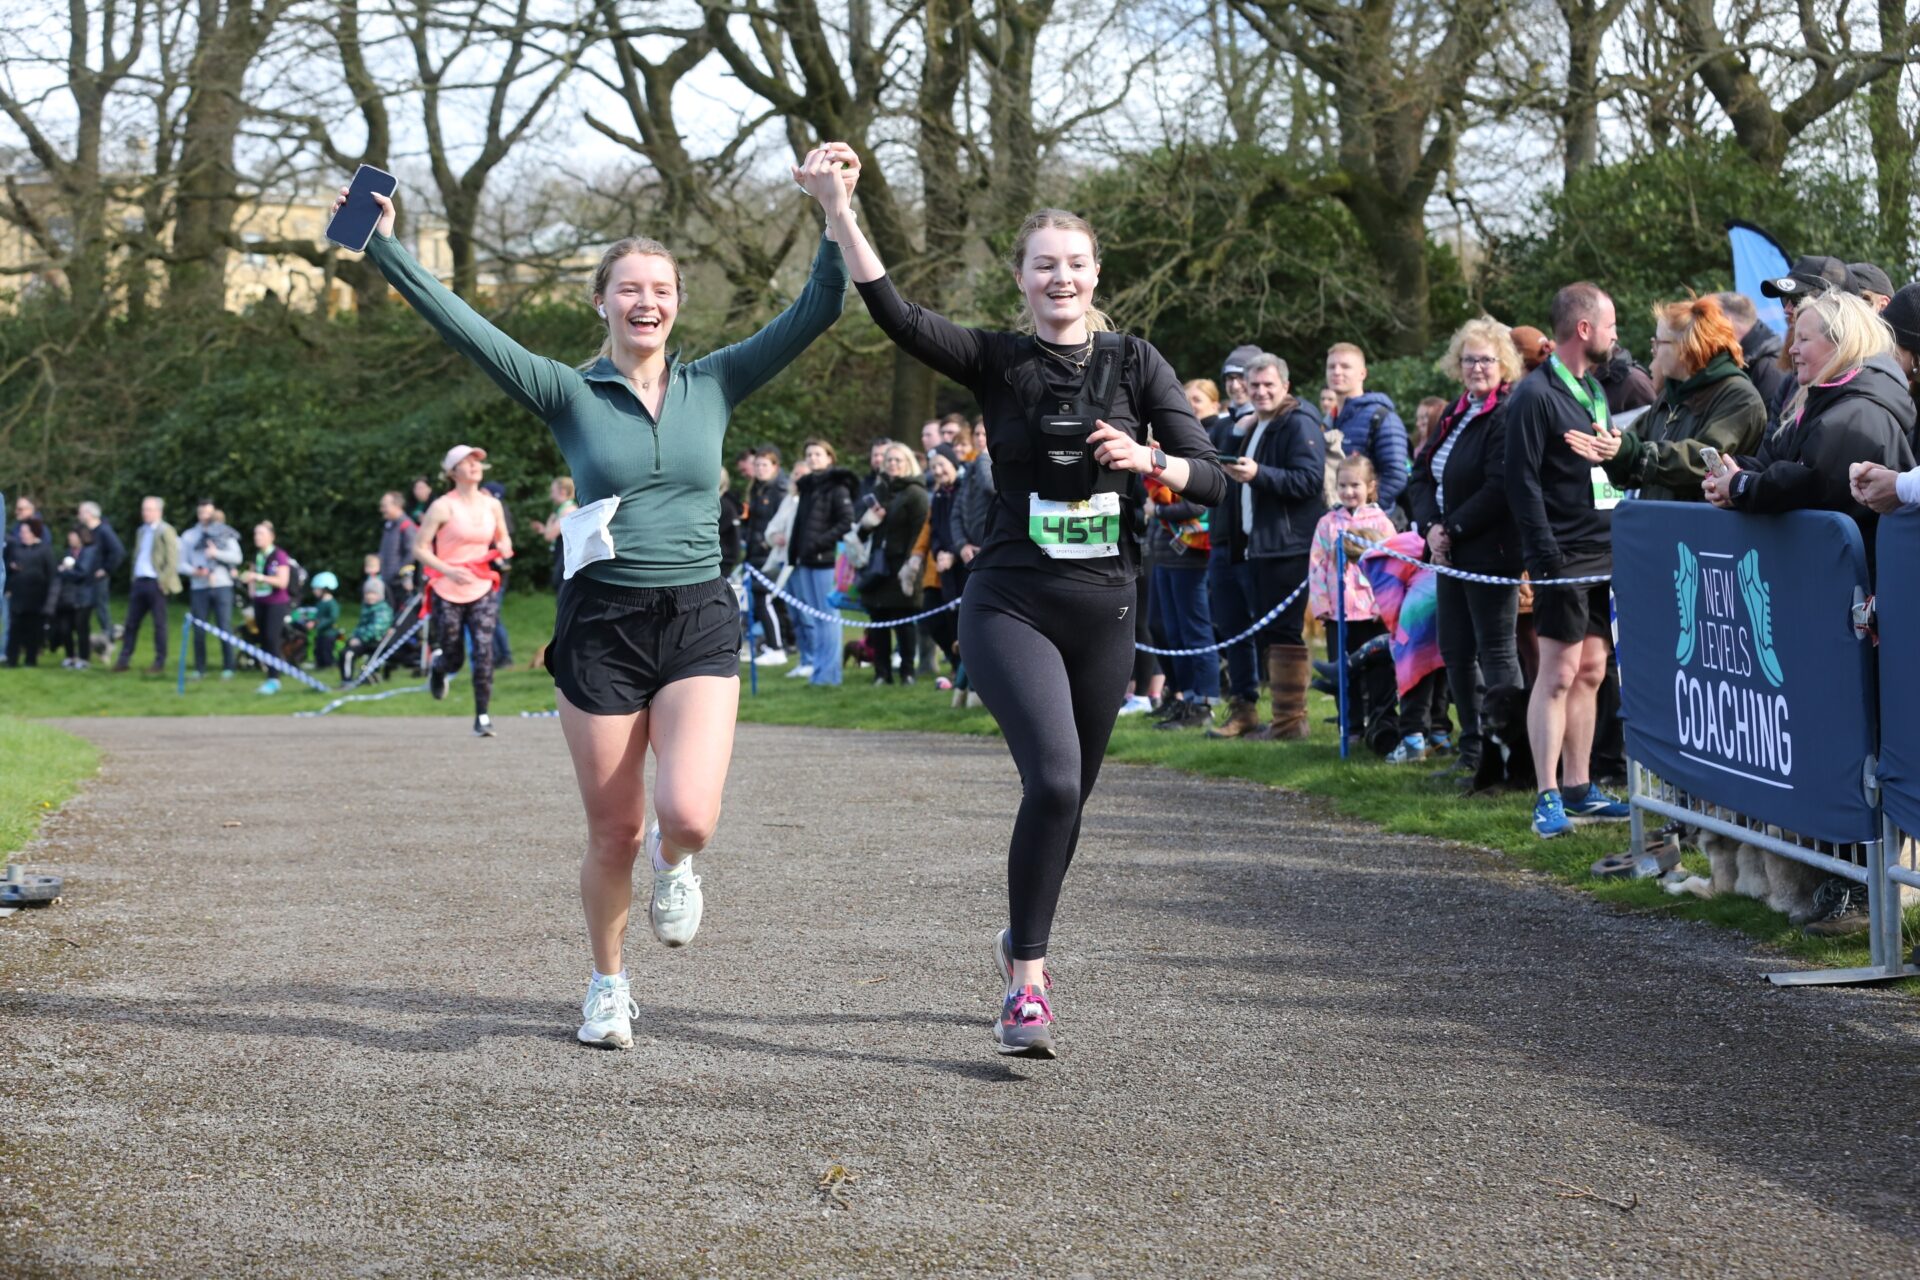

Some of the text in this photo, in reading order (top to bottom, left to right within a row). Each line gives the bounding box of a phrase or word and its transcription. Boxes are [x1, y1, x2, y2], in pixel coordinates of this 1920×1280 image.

[1042, 516, 1108, 544] 454
[1702, 567, 1735, 620] NEW
[1699, 620, 1752, 678] LEVELS
[1674, 669, 1792, 776] COACHING
